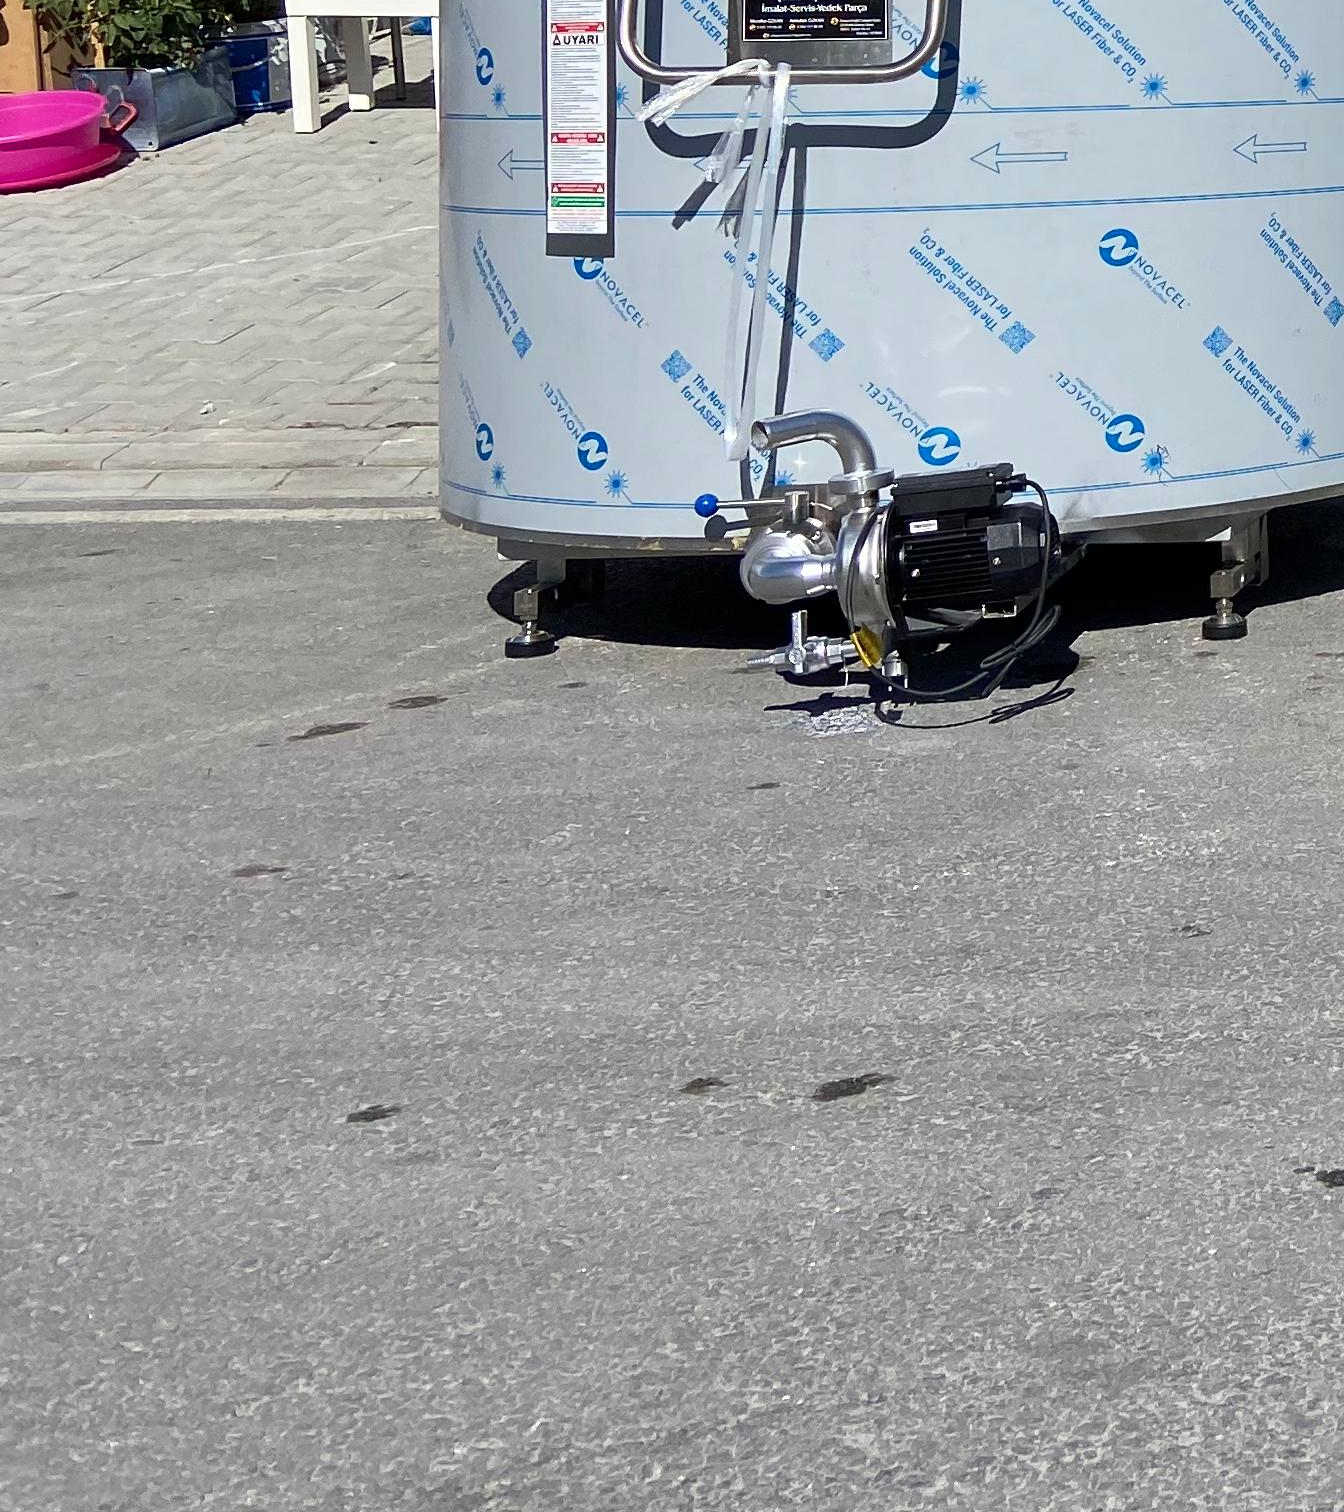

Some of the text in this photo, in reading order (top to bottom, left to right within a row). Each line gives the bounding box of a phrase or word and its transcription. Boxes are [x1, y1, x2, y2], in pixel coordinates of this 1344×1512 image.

[563, 35, 598, 45] UYARI
[693, 10, 721, 41] LASER
[1062, 5, 1093, 36] LASER
[1091, 33, 1115, 56] Fiber
[1113, 55, 1123, 64] &
[1232, 4, 1258, 34] LASER
[1255, 31, 1274, 54] Fiber
[1273, 52, 1281, 62] &
[1112, 30, 1146, 66] Solution
[1272, 28, 1299, 62] Solution
[1279, 229, 1287, 239] &
[1286, 237, 1303, 259] Fiber
[934, 247, 946, 258] &
[943, 256, 969, 279] Fiber
[1260, 229, 1323, 307] The Novacel Solution
[1300, 256, 1323, 284] LASER
[600, 271, 645, 328] NOVACEL
[909, 246, 998, 332] The Novacel Solution
[966, 276, 998, 307] LASER
[1134, 256, 1185, 309] NOVACEL
[1321, 280, 1332, 295] for
[765, 293, 791, 321] Novac
[776, 282, 822, 327] for LASER
[996, 304, 1012, 319] for
[692, 373, 708, 394] The
[1056, 372, 1111, 425] NOVACEL
[1222, 358, 1236, 374] for
[1234, 370, 1260, 399] LASER
[1257, 395, 1277, 417] Fiber
[1275, 414, 1282, 424] &
[1234, 346, 1300, 423] The Novacel Solution
[543, 381, 581, 440] NOVACEL
[681, 386, 695, 402] for
[692, 398, 721, 431] LASER
[865, 382, 923, 437] NOVACEL
